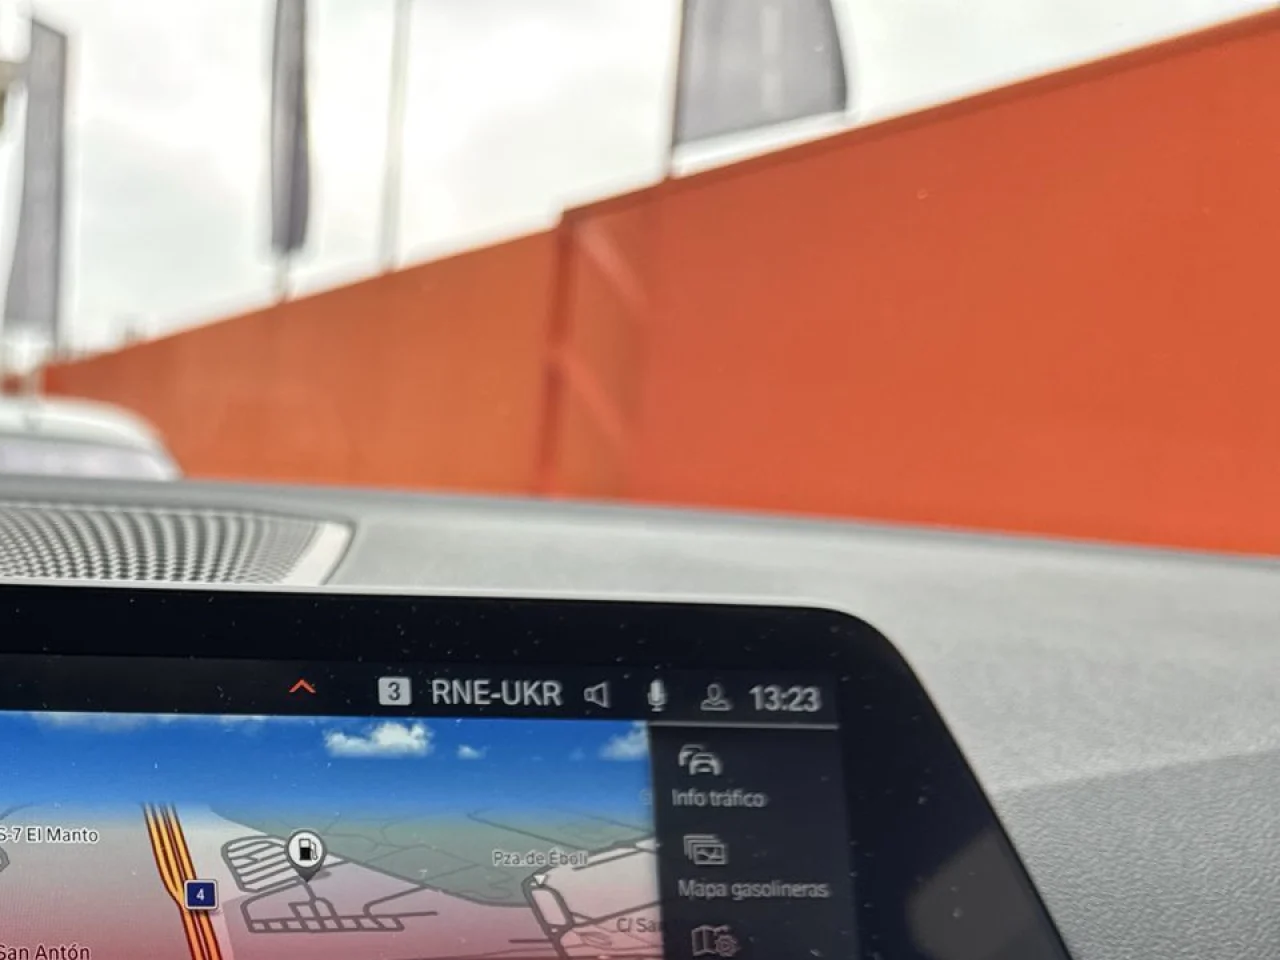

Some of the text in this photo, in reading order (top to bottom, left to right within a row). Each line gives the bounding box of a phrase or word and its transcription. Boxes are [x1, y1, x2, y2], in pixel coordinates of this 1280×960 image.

[431, 679, 562, 706] RNE-UKR
[749, 685, 821, 712] 13:23
[672, 788, 706, 807] Info
[710, 788, 766, 808] tráfico
[26, 828, 42, 842] El
[46, 828, 99, 843] Manto
[526, 851, 546, 865] de
[678, 879, 829, 904] Mapa gasolineras
[35, 944, 90, 960] Antón
